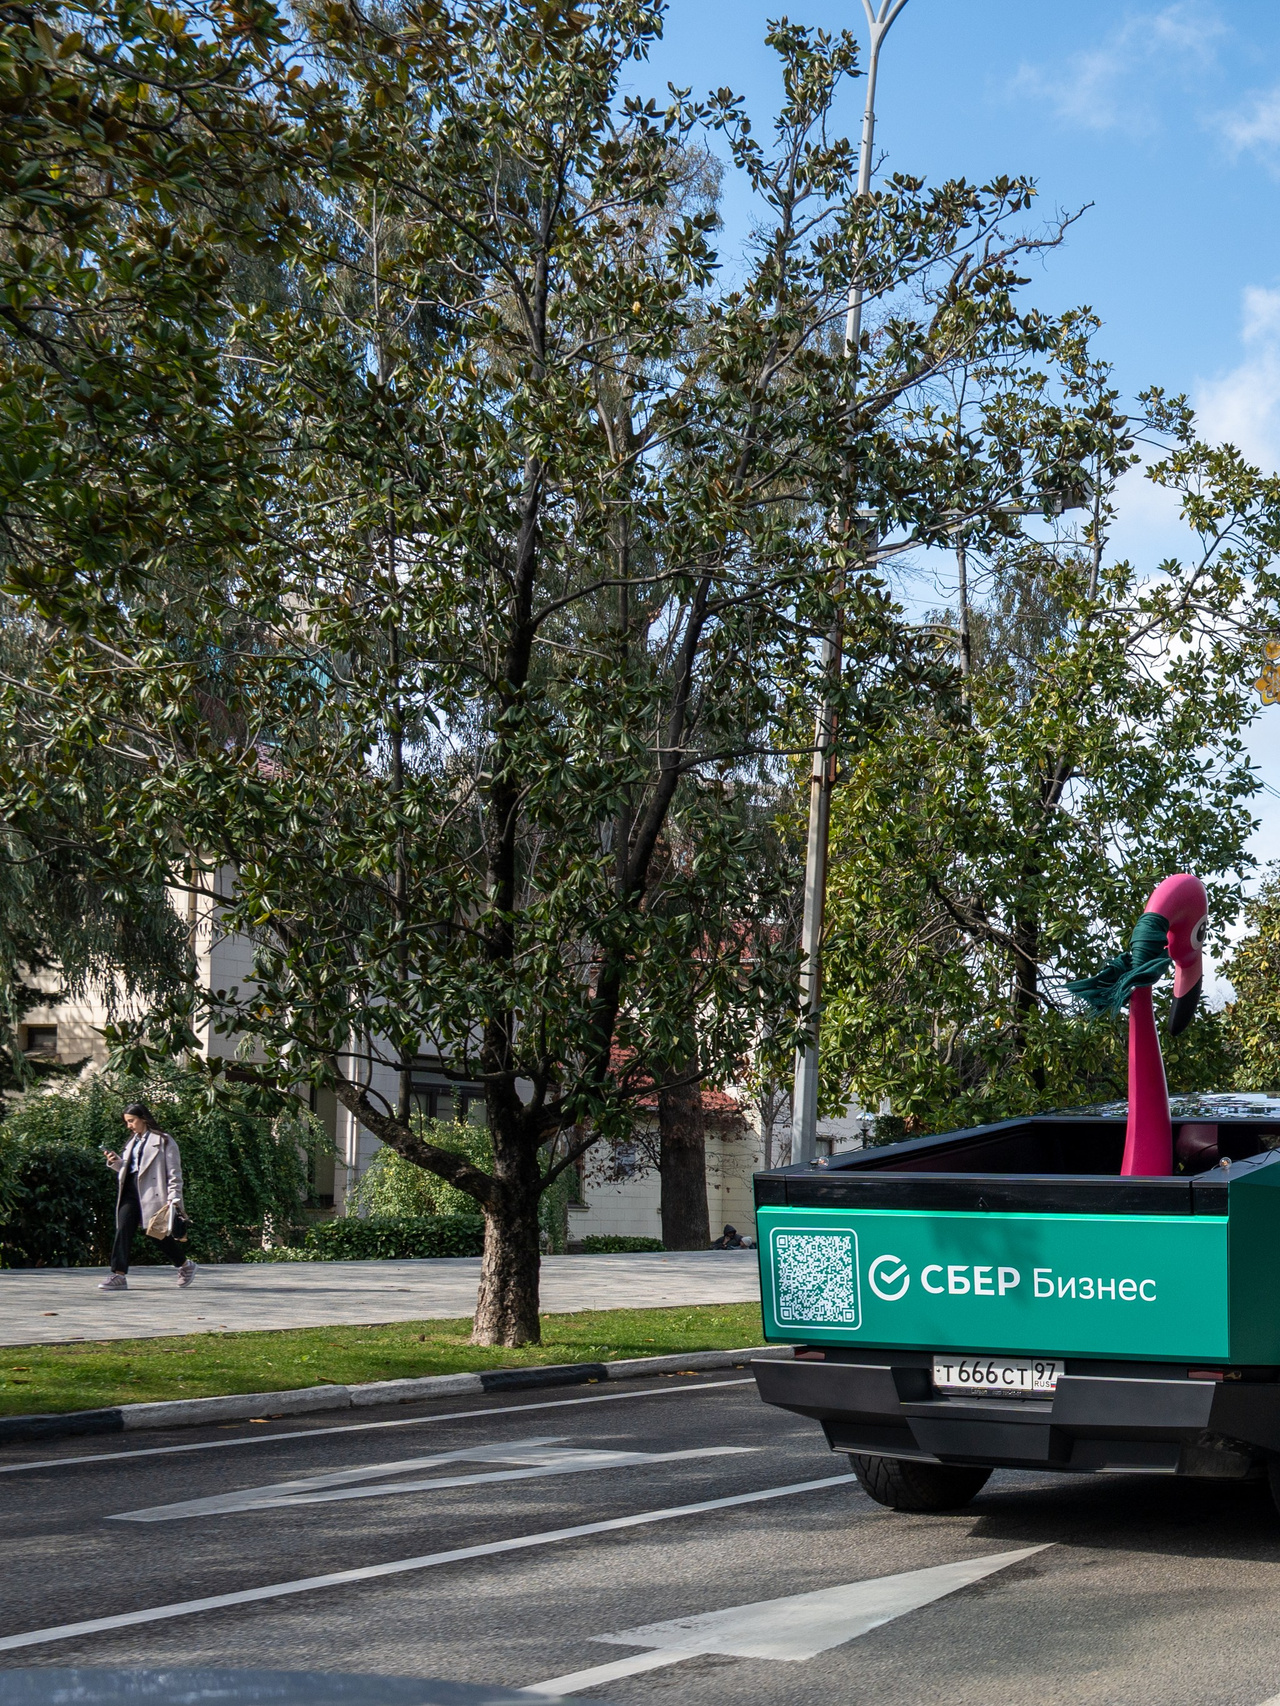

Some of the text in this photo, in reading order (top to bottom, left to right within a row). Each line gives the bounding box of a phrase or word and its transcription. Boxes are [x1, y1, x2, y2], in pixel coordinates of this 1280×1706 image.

[920, 1264, 1157, 1301] СБЕР Бизнес
[942, 1360, 1056, 1385] Т666СТ 97
[1034, 1380, 1050, 1388] RUS
